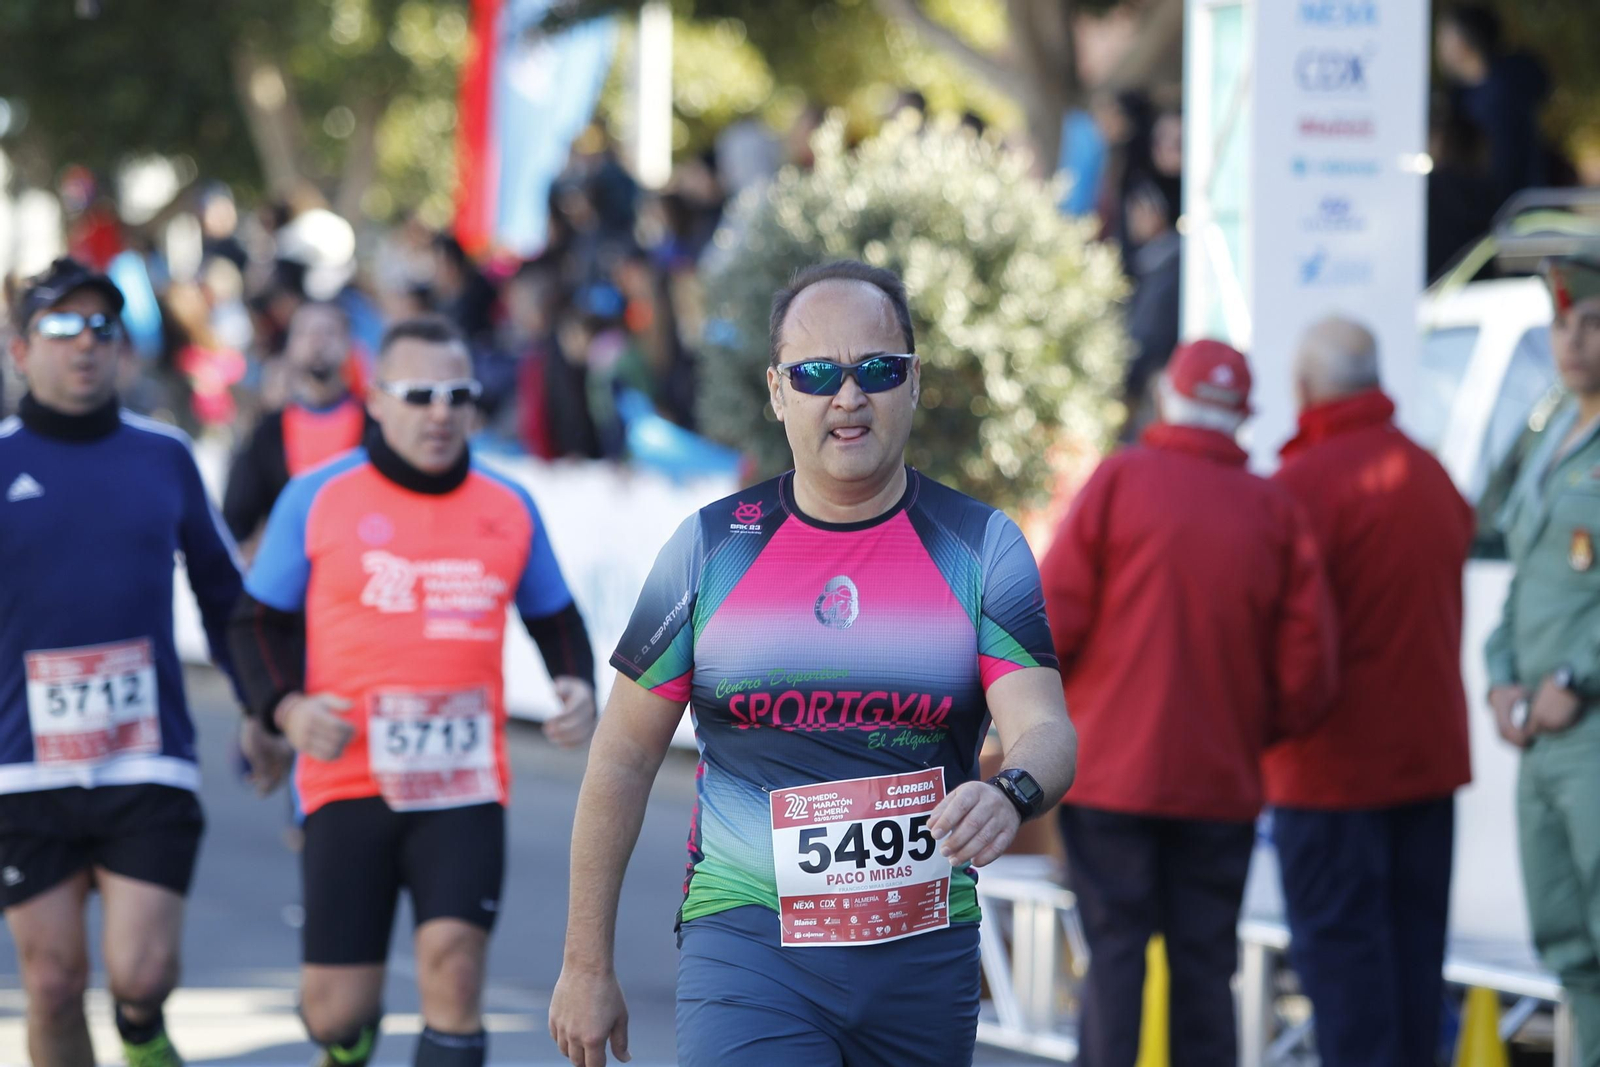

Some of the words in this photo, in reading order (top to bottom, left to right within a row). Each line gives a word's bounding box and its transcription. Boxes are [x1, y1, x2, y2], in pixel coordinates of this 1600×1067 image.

[715, 677, 762, 698] Centro
[767, 668, 849, 686] Deportivo
[46, 675, 141, 718] 5712
[728, 690, 953, 731] SPORTGYM
[387, 717, 479, 755] 5713
[868, 732, 887, 749] El
[887, 780, 935, 796] CARRERA
[812, 792, 838, 802] MEDIO
[813, 797, 853, 810] MARATÓN
[875, 792, 936, 811] SALUDABLE
[813, 805, 850, 817] ALMERÍA
[798, 815, 936, 874] 5495
[826, 872, 865, 886] PACO
[869, 865, 913, 881] MIRAS
[838, 885, 868, 893] FRANCISCO
[793, 900, 815, 910] NEXA
[820, 898, 837, 908] CDX
[854, 895, 880, 904] ALMERÍA
[793, 919, 818, 927] Blanes
[802, 931, 825, 939] cajamar
